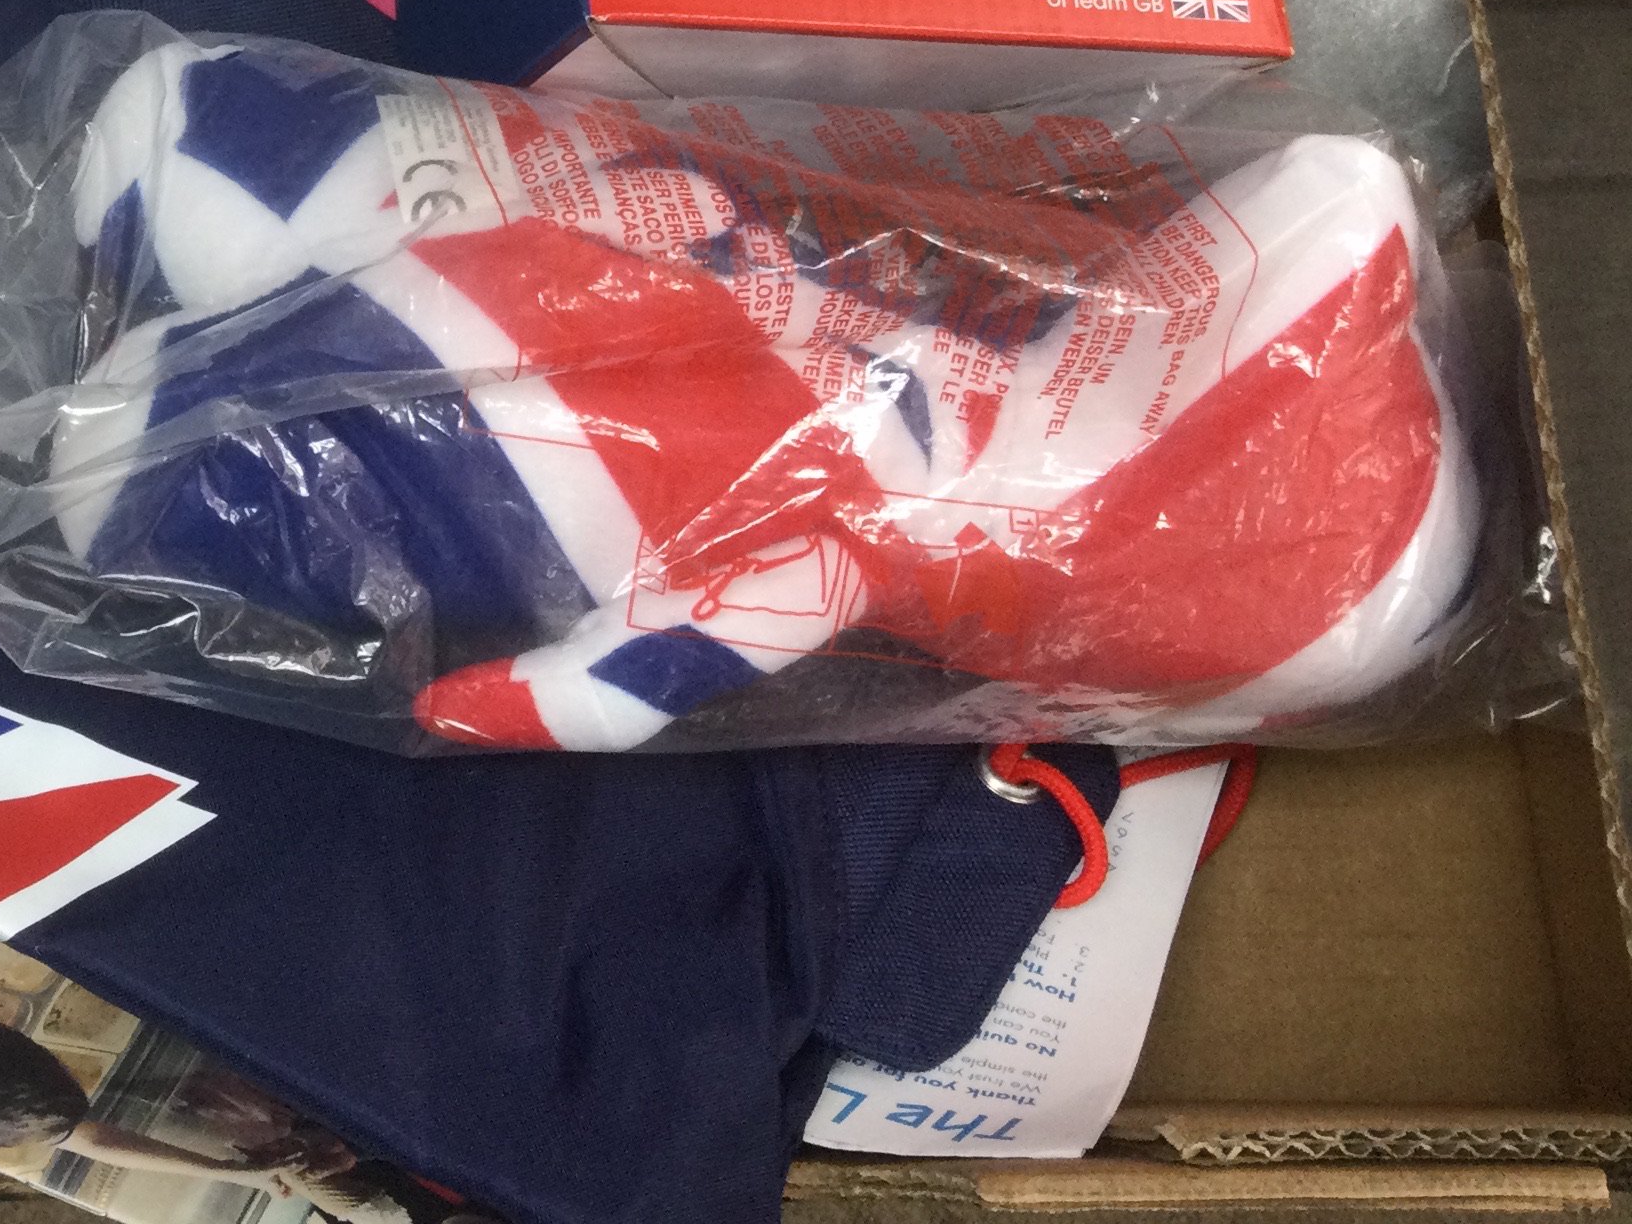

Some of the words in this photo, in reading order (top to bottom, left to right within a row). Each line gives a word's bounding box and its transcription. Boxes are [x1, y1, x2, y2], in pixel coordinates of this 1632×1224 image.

[551, 129, 603, 220] IMPORTANTE
[648, 170, 673, 199] SER
[636, 194, 666, 245] SACO
[1178, 213, 1218, 246] FIRST
[1160, 225, 1185, 244] BE
[753, 273, 774, 313] LOS
[1167, 265, 1202, 299] KEEP
[771, 282, 795, 328] ESTE
[1176, 305, 1201, 346] THIS
[1078, 315, 1115, 374] DEISER
[949, 353, 969, 377] ET
[1089, 363, 1116, 385] UM
[1162, 349, 1185, 386] BAG
[939, 380, 960, 405] LE
[1044, 378, 1084, 440] BEUTEL
[1139, 391, 1170, 435] AWAY
[1023, 978, 1076, 1003] How
[992, 1016, 1024, 1031] can
[1029, 1027, 1060, 1043] You
[1025, 1042, 1058, 1057] No
[960, 1054, 1020, 1075] simple
[914, 1074, 958, 1091] you
[967, 1086, 1037, 1106] Thank
